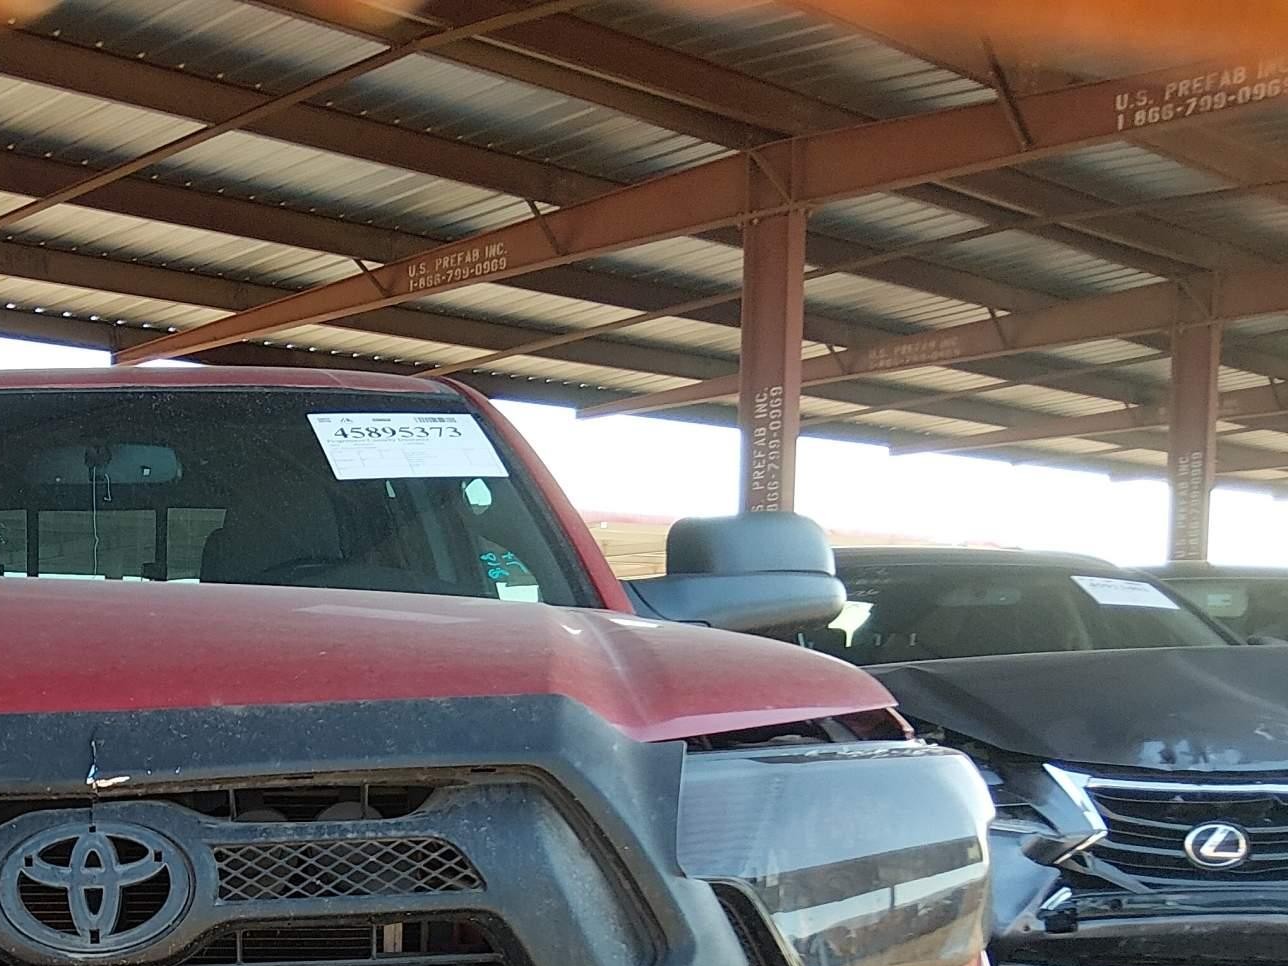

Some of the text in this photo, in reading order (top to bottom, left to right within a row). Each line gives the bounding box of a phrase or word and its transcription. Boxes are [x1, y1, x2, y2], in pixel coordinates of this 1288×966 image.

[1114, 89, 1154, 111] U.S.
[1164, 66, 1247, 100] PREFAB
[408, 242, 508, 278] U.S. PREFAB INC.
[409, 257, 507, 292] 1-866-799-0969
[754, 386, 770, 419] INC.
[333, 425, 463, 439] 45895373
[752, 427, 767, 490] PREFAB
